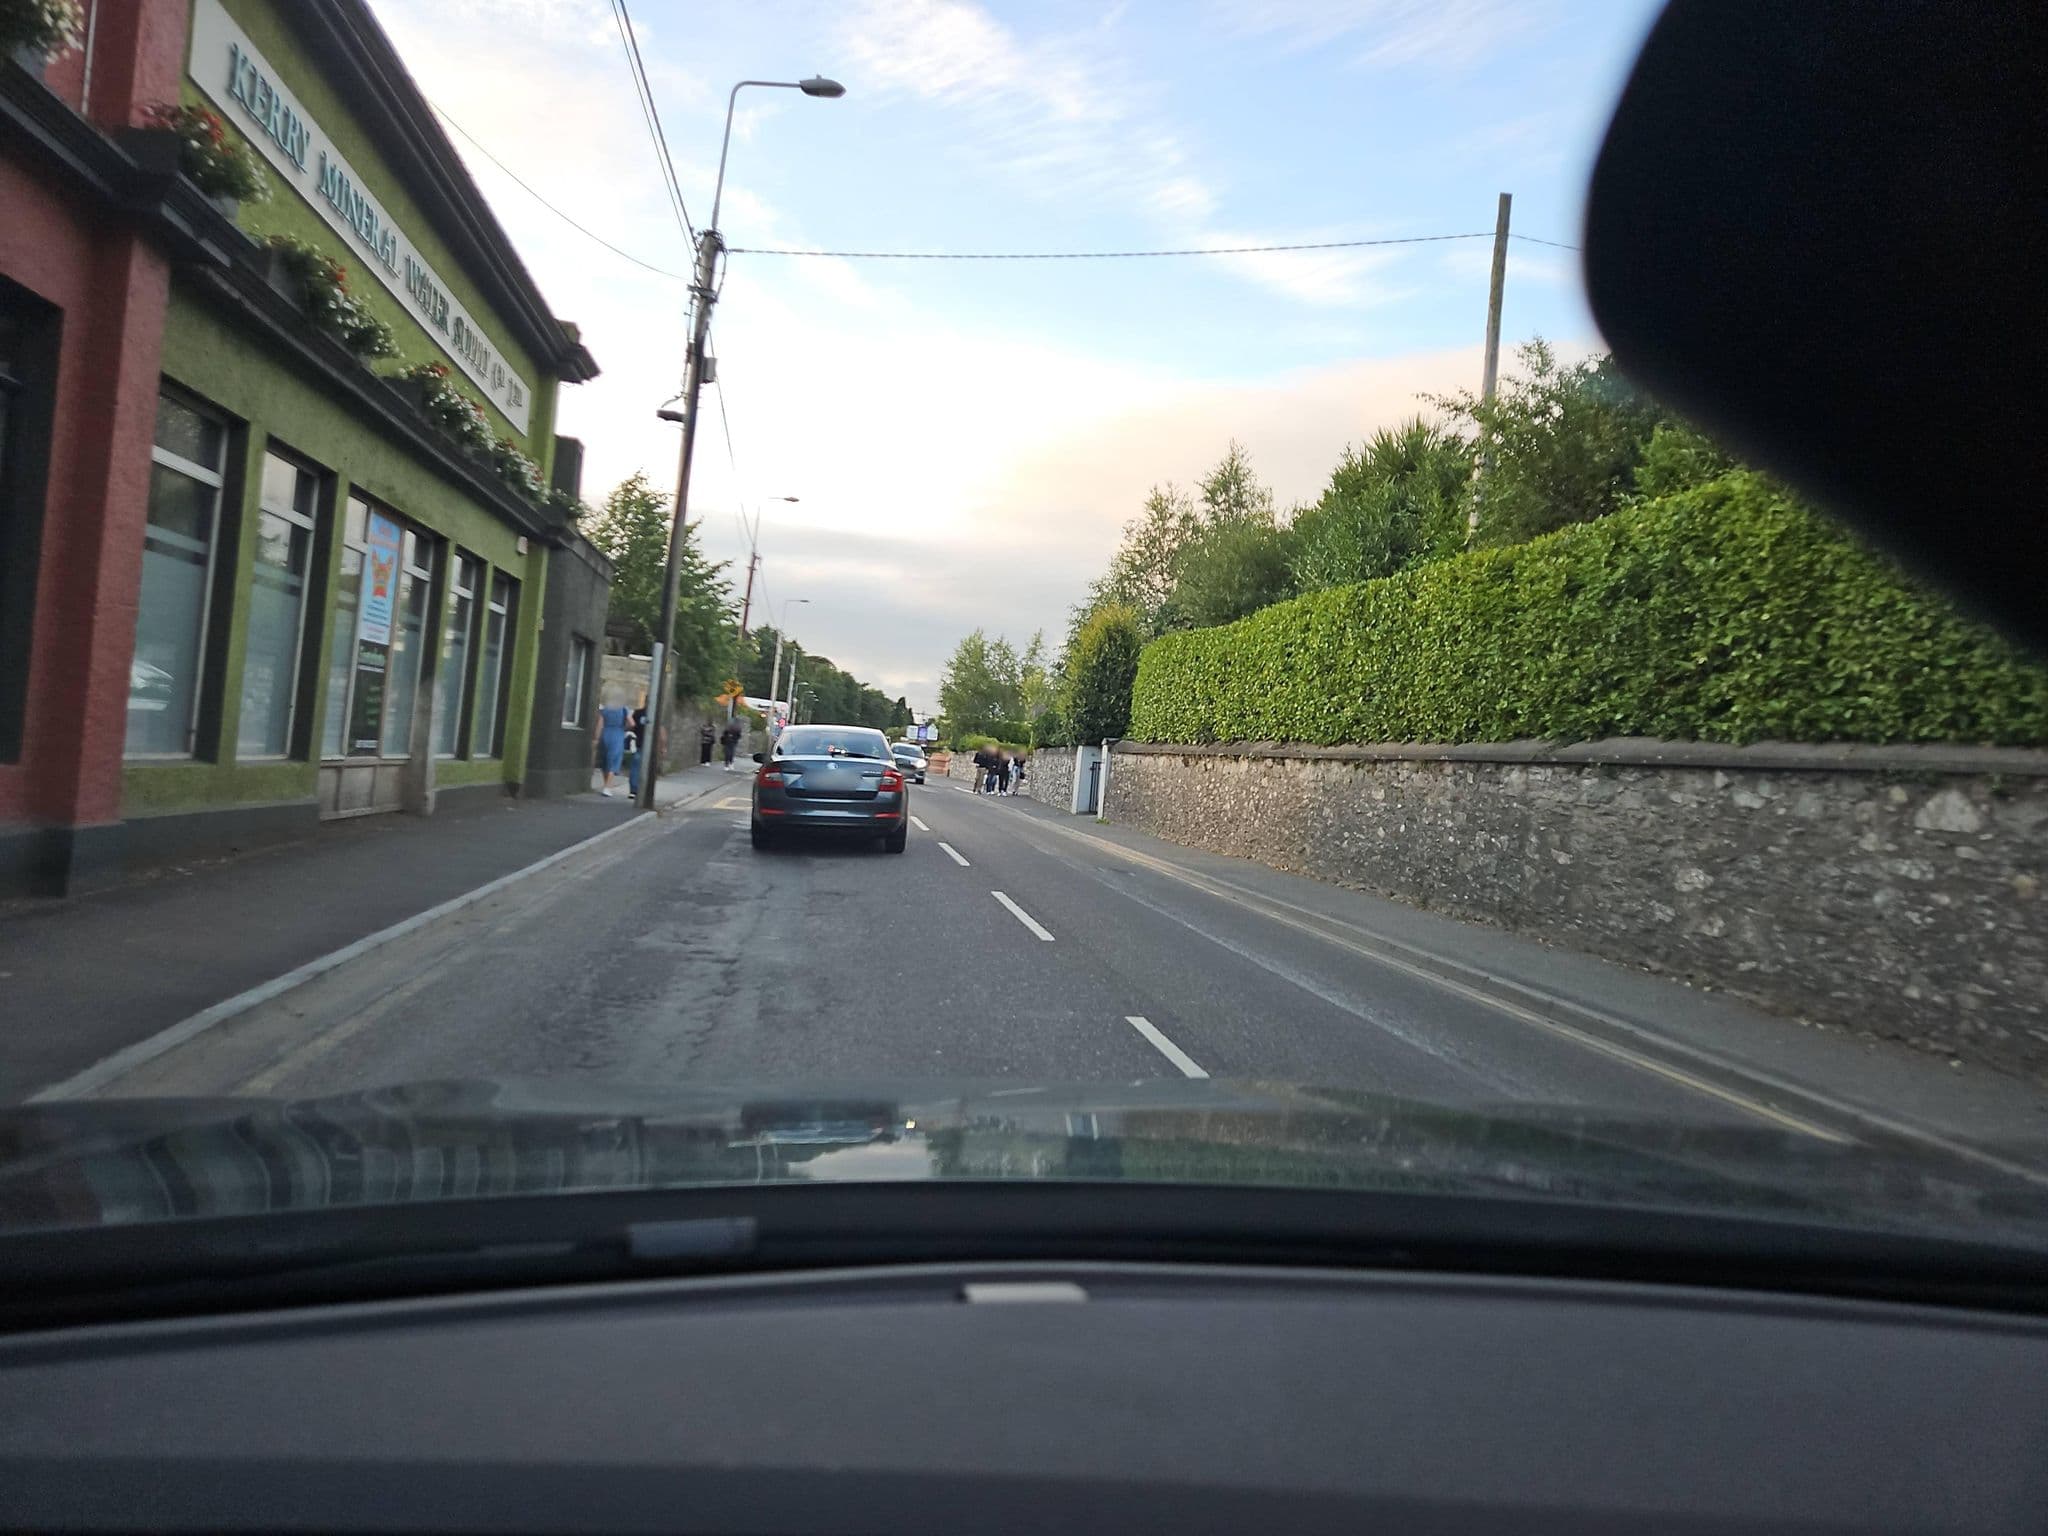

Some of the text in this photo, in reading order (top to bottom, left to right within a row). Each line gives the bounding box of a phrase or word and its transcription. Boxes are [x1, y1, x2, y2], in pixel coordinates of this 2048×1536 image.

[229, 41, 311, 174] KERRY
[317, 150, 401, 280] MINERAL
[404, 254, 450, 336] WATER
